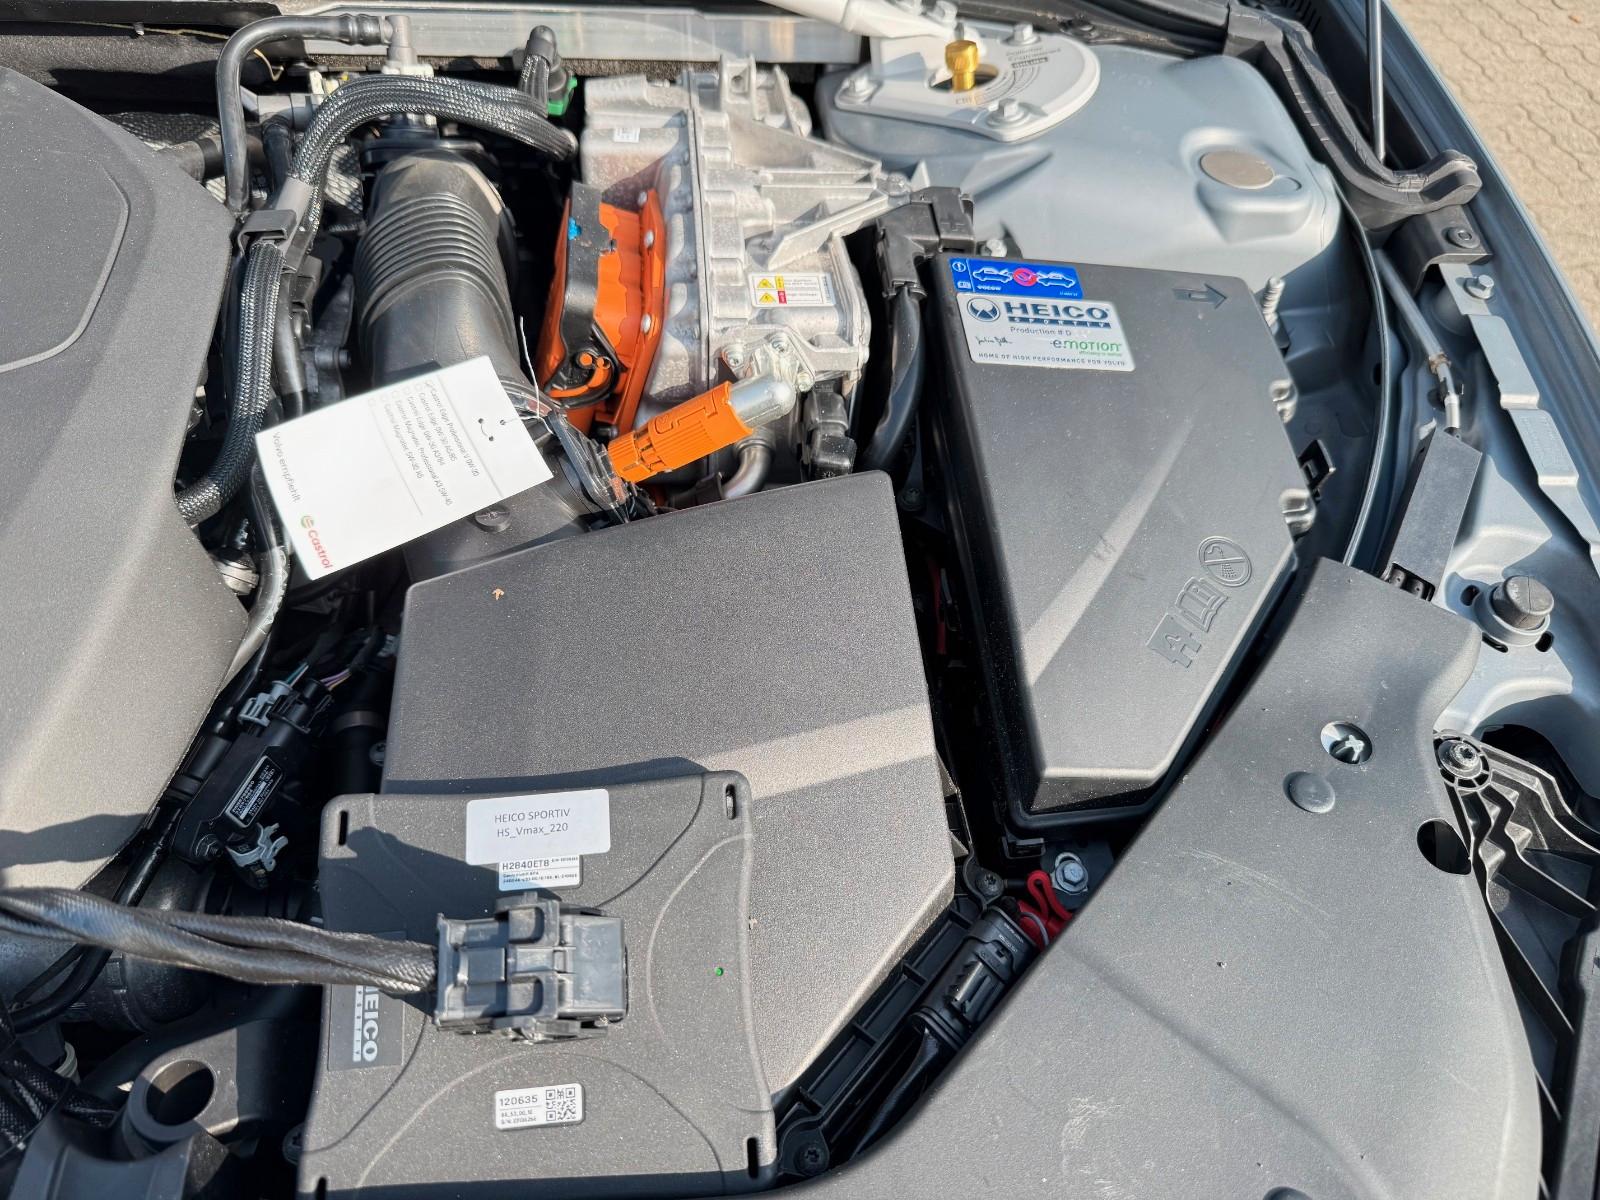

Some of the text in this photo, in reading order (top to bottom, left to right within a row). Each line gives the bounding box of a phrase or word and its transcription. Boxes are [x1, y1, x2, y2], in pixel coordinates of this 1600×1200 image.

[1004, 301, 1107, 319] HEICO
[1010, 326, 1056, 335] Production
[273, 432, 282, 458] Volvo
[307, 528, 332, 569] Castrol
[494, 808, 570, 823] HEICO SPORTIV
[497, 822, 568, 838] HS_Vmax_220
[499, 1094, 539, 1107] 120635
